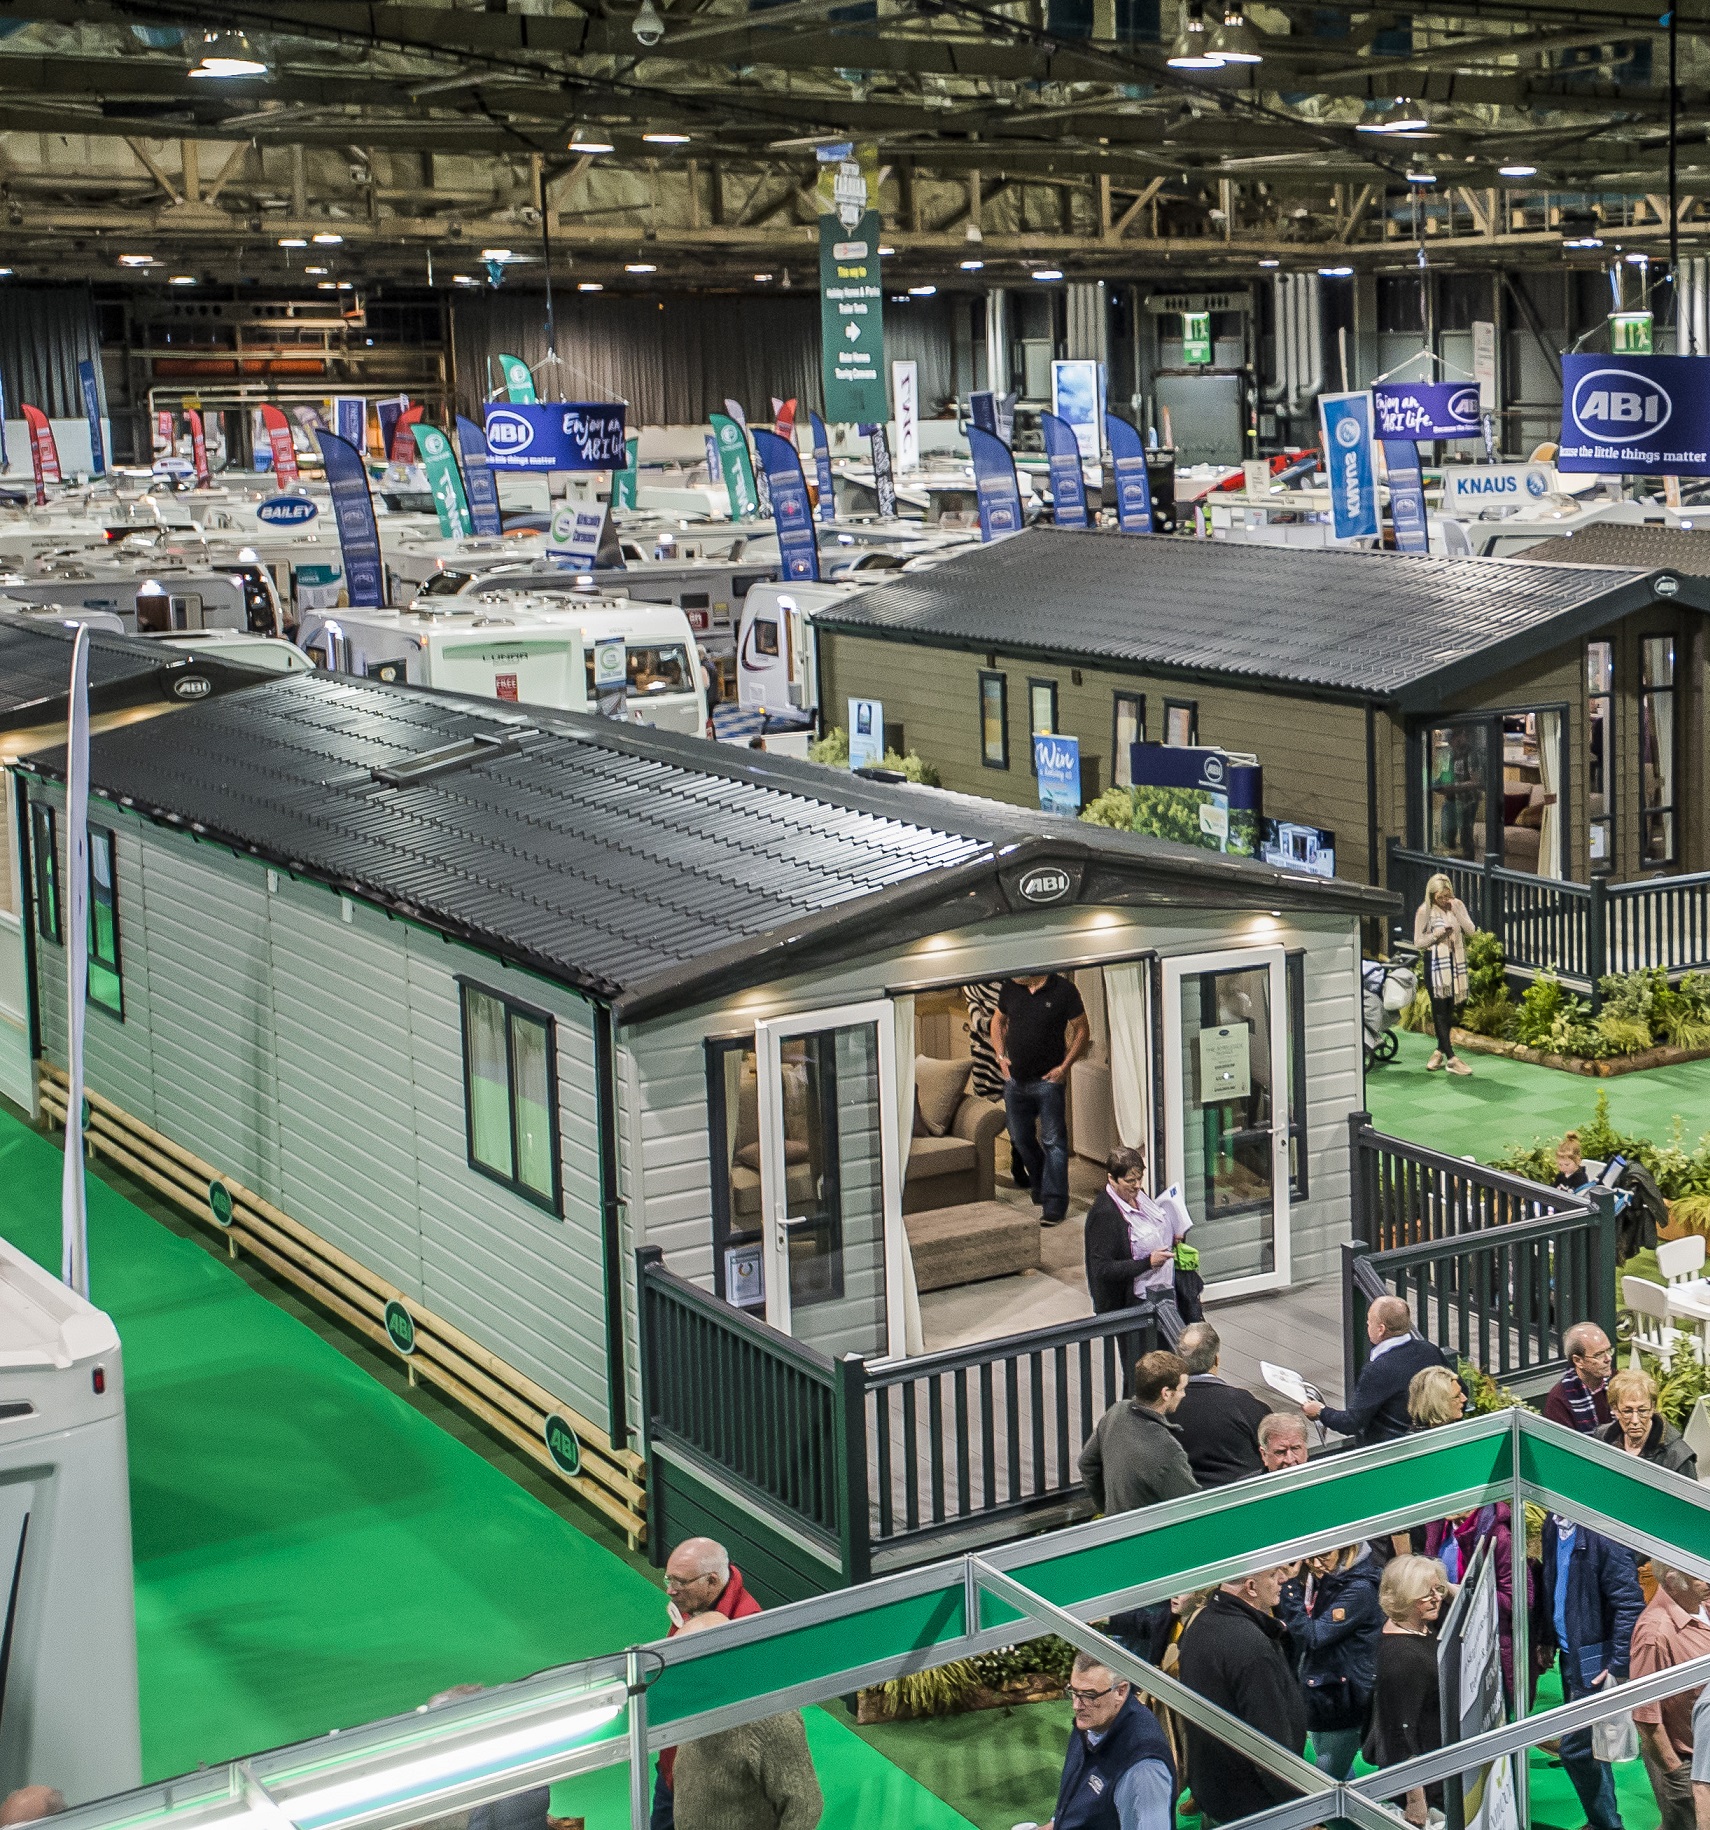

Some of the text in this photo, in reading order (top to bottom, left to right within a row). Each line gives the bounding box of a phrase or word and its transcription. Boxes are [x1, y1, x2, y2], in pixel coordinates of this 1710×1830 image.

[1375, 392, 1420, 420] Enjoy an
[1579, 390, 1659, 423] ABI
[489, 423, 526, 443] ABI
[563, 412, 604, 446] Enjoy
[1578, 446, 1593, 458] the
[1594, 446, 1619, 460] little
[1621, 448, 1660, 463] things
[1663, 451, 1707, 463] matter
[1345, 451, 1361, 519] KNAUS
[1457, 476, 1517, 495] KNAUS
[261, 505, 314, 519] BAILEY
[482, 652, 529, 661] LUNAR
[179, 682, 207, 693] ABI
[496, 680, 517, 689] FREE
[1035, 741, 1074, 769] Win
[1025, 875, 1065, 894] ABI
[390, 1312, 412, 1343] ABI
[550, 1428, 577, 1465] ABI
